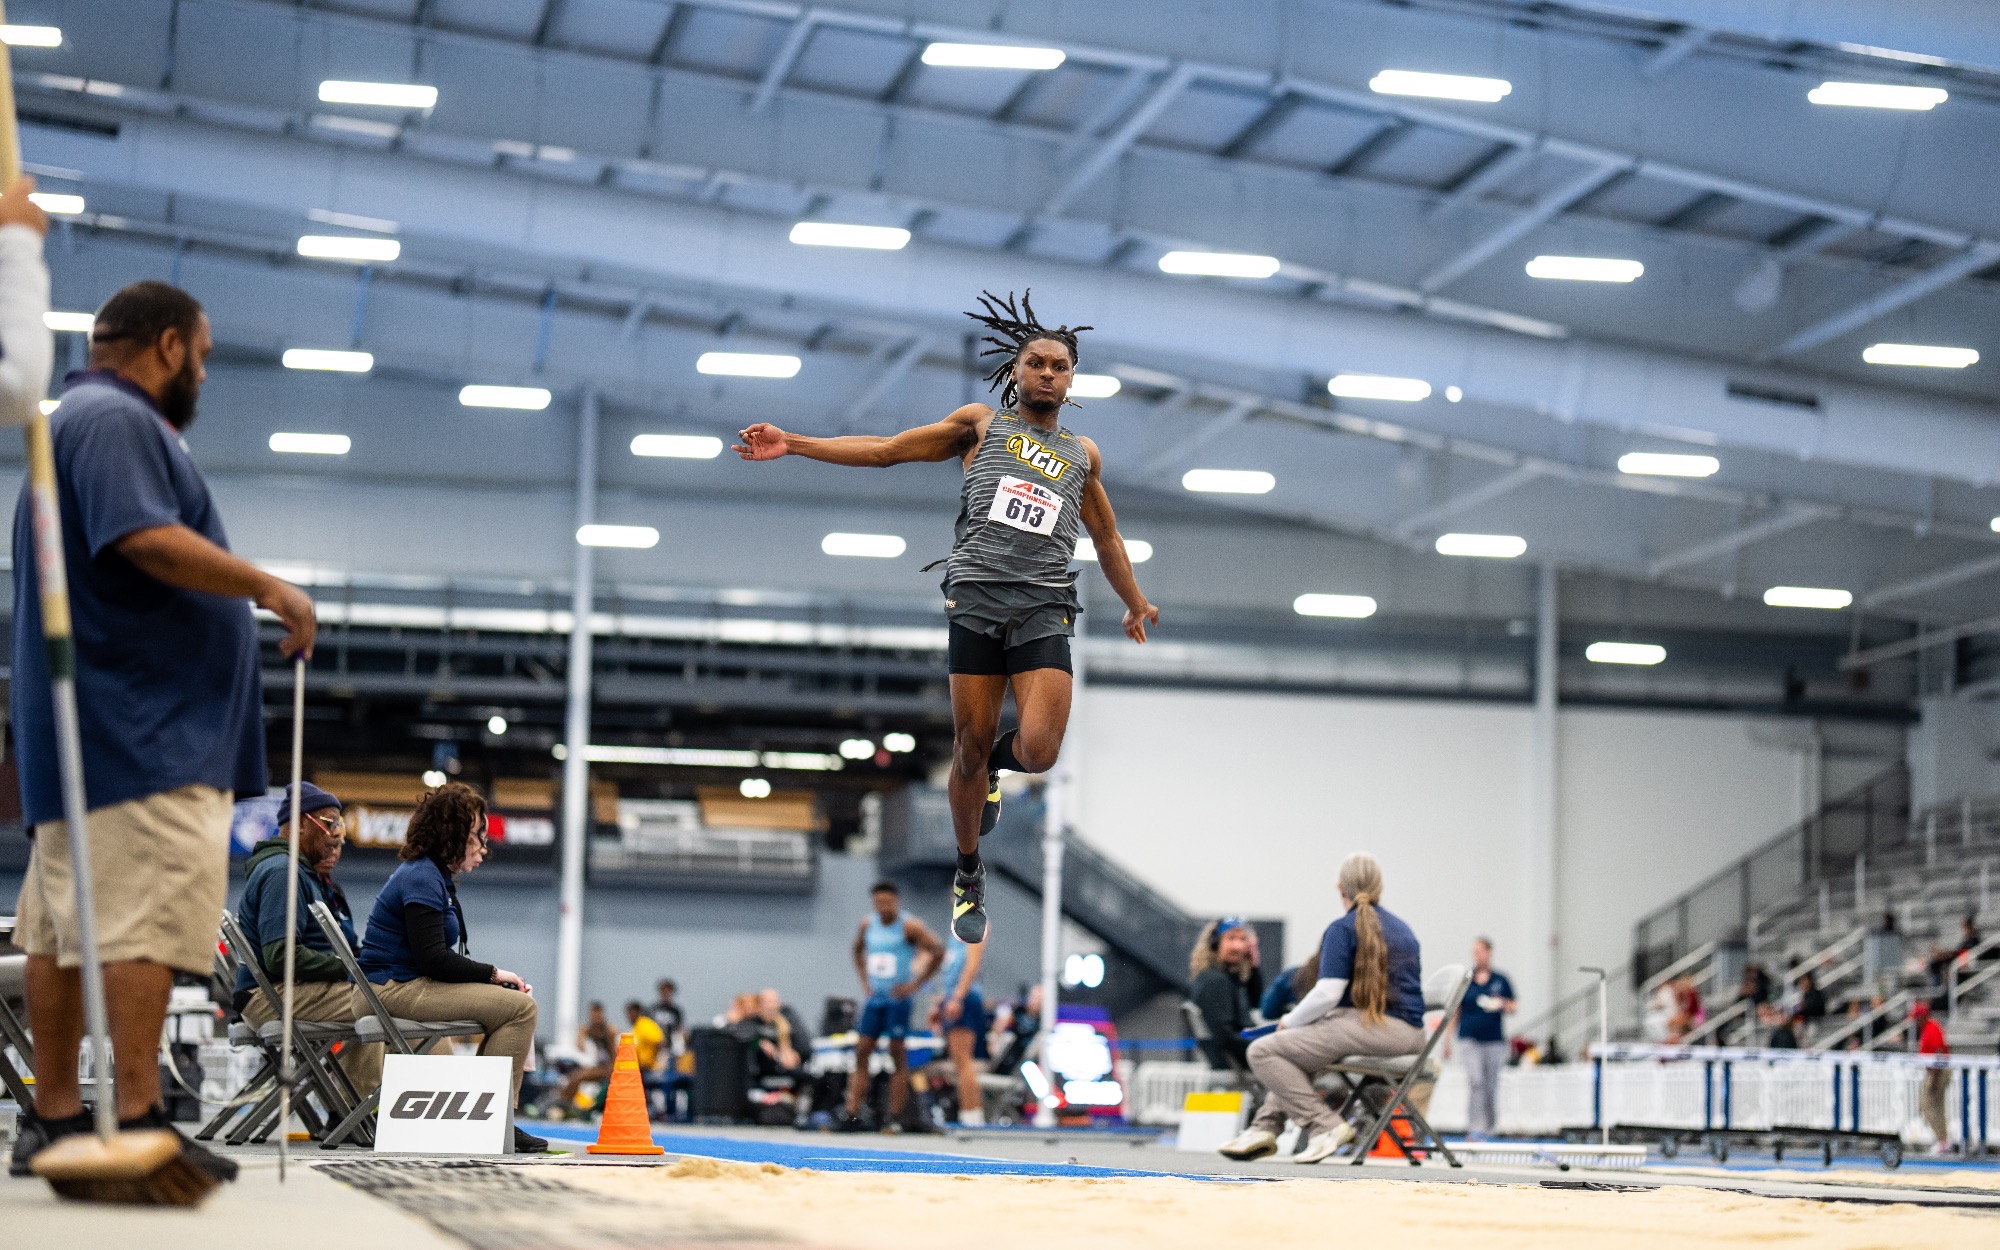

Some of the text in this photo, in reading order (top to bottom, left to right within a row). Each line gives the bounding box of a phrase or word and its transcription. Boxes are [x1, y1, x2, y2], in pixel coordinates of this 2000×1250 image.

[1008, 434, 1068, 479] VCU
[1002, 486, 1057, 511] CHAMPIONSHIPS
[1005, 497, 1046, 527] 613
[389, 1090, 496, 1121] GILL
